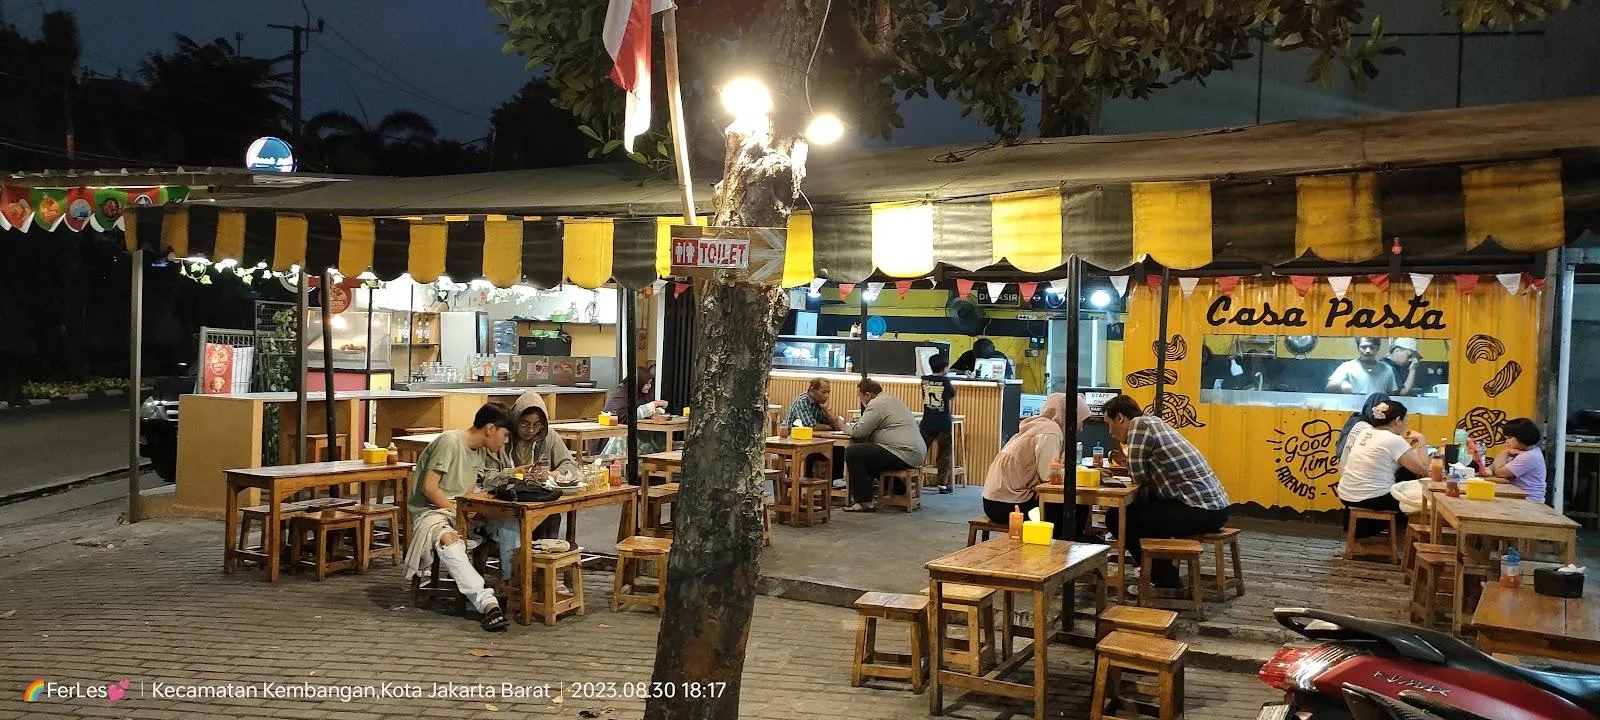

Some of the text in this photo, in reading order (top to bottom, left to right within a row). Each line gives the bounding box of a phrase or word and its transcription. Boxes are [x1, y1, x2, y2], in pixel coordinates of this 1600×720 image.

[700, 243, 746, 265] TOILET
[999, 293, 1018, 301] ASIR
[1206, 295, 1447, 330] Casa Pasta
[1284, 419, 1341, 462] Good
[1297, 449, 1340, 480] Time
[1275, 466, 1316, 500] FRIENDS
